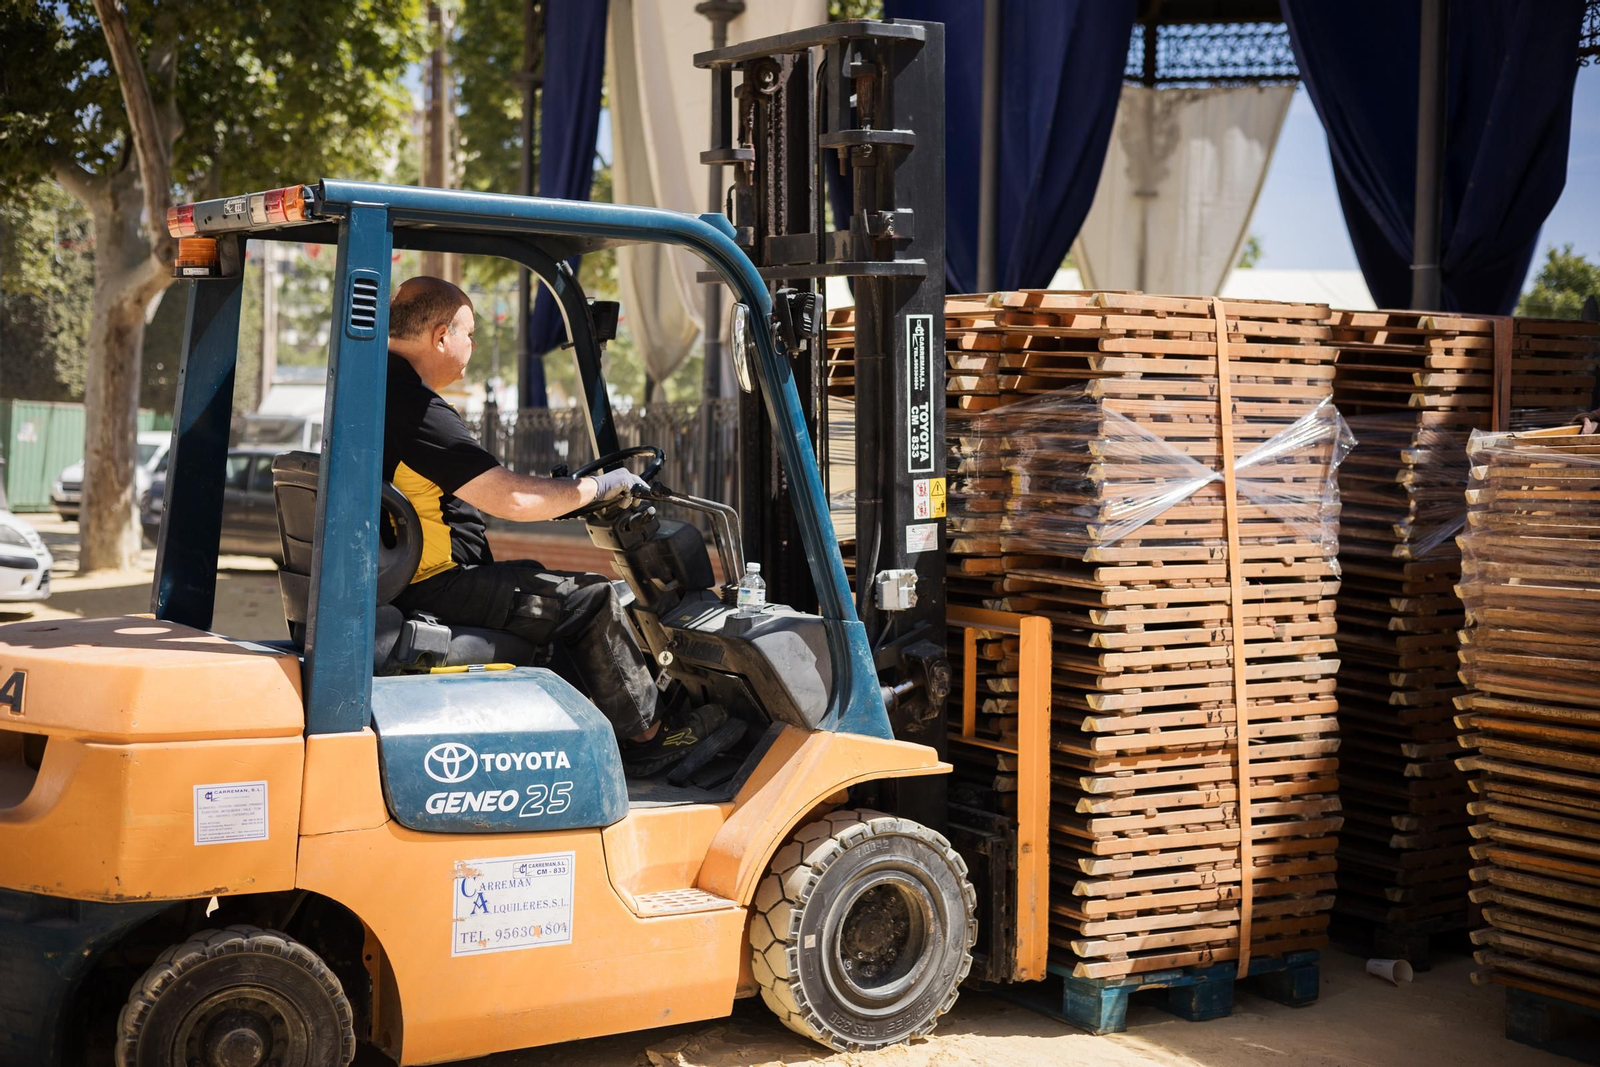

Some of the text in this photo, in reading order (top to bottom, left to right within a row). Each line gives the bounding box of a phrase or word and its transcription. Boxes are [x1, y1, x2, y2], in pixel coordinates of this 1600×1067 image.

[911, 405, 919, 426] CM
[919, 401, 929, 463] TOYOTA
[911, 436, 920, 459] 833
[480, 750, 571, 772] TOYOTA
[425, 781, 573, 817] GENEO 25
[460, 922, 567, 944] TEL. 95630804
